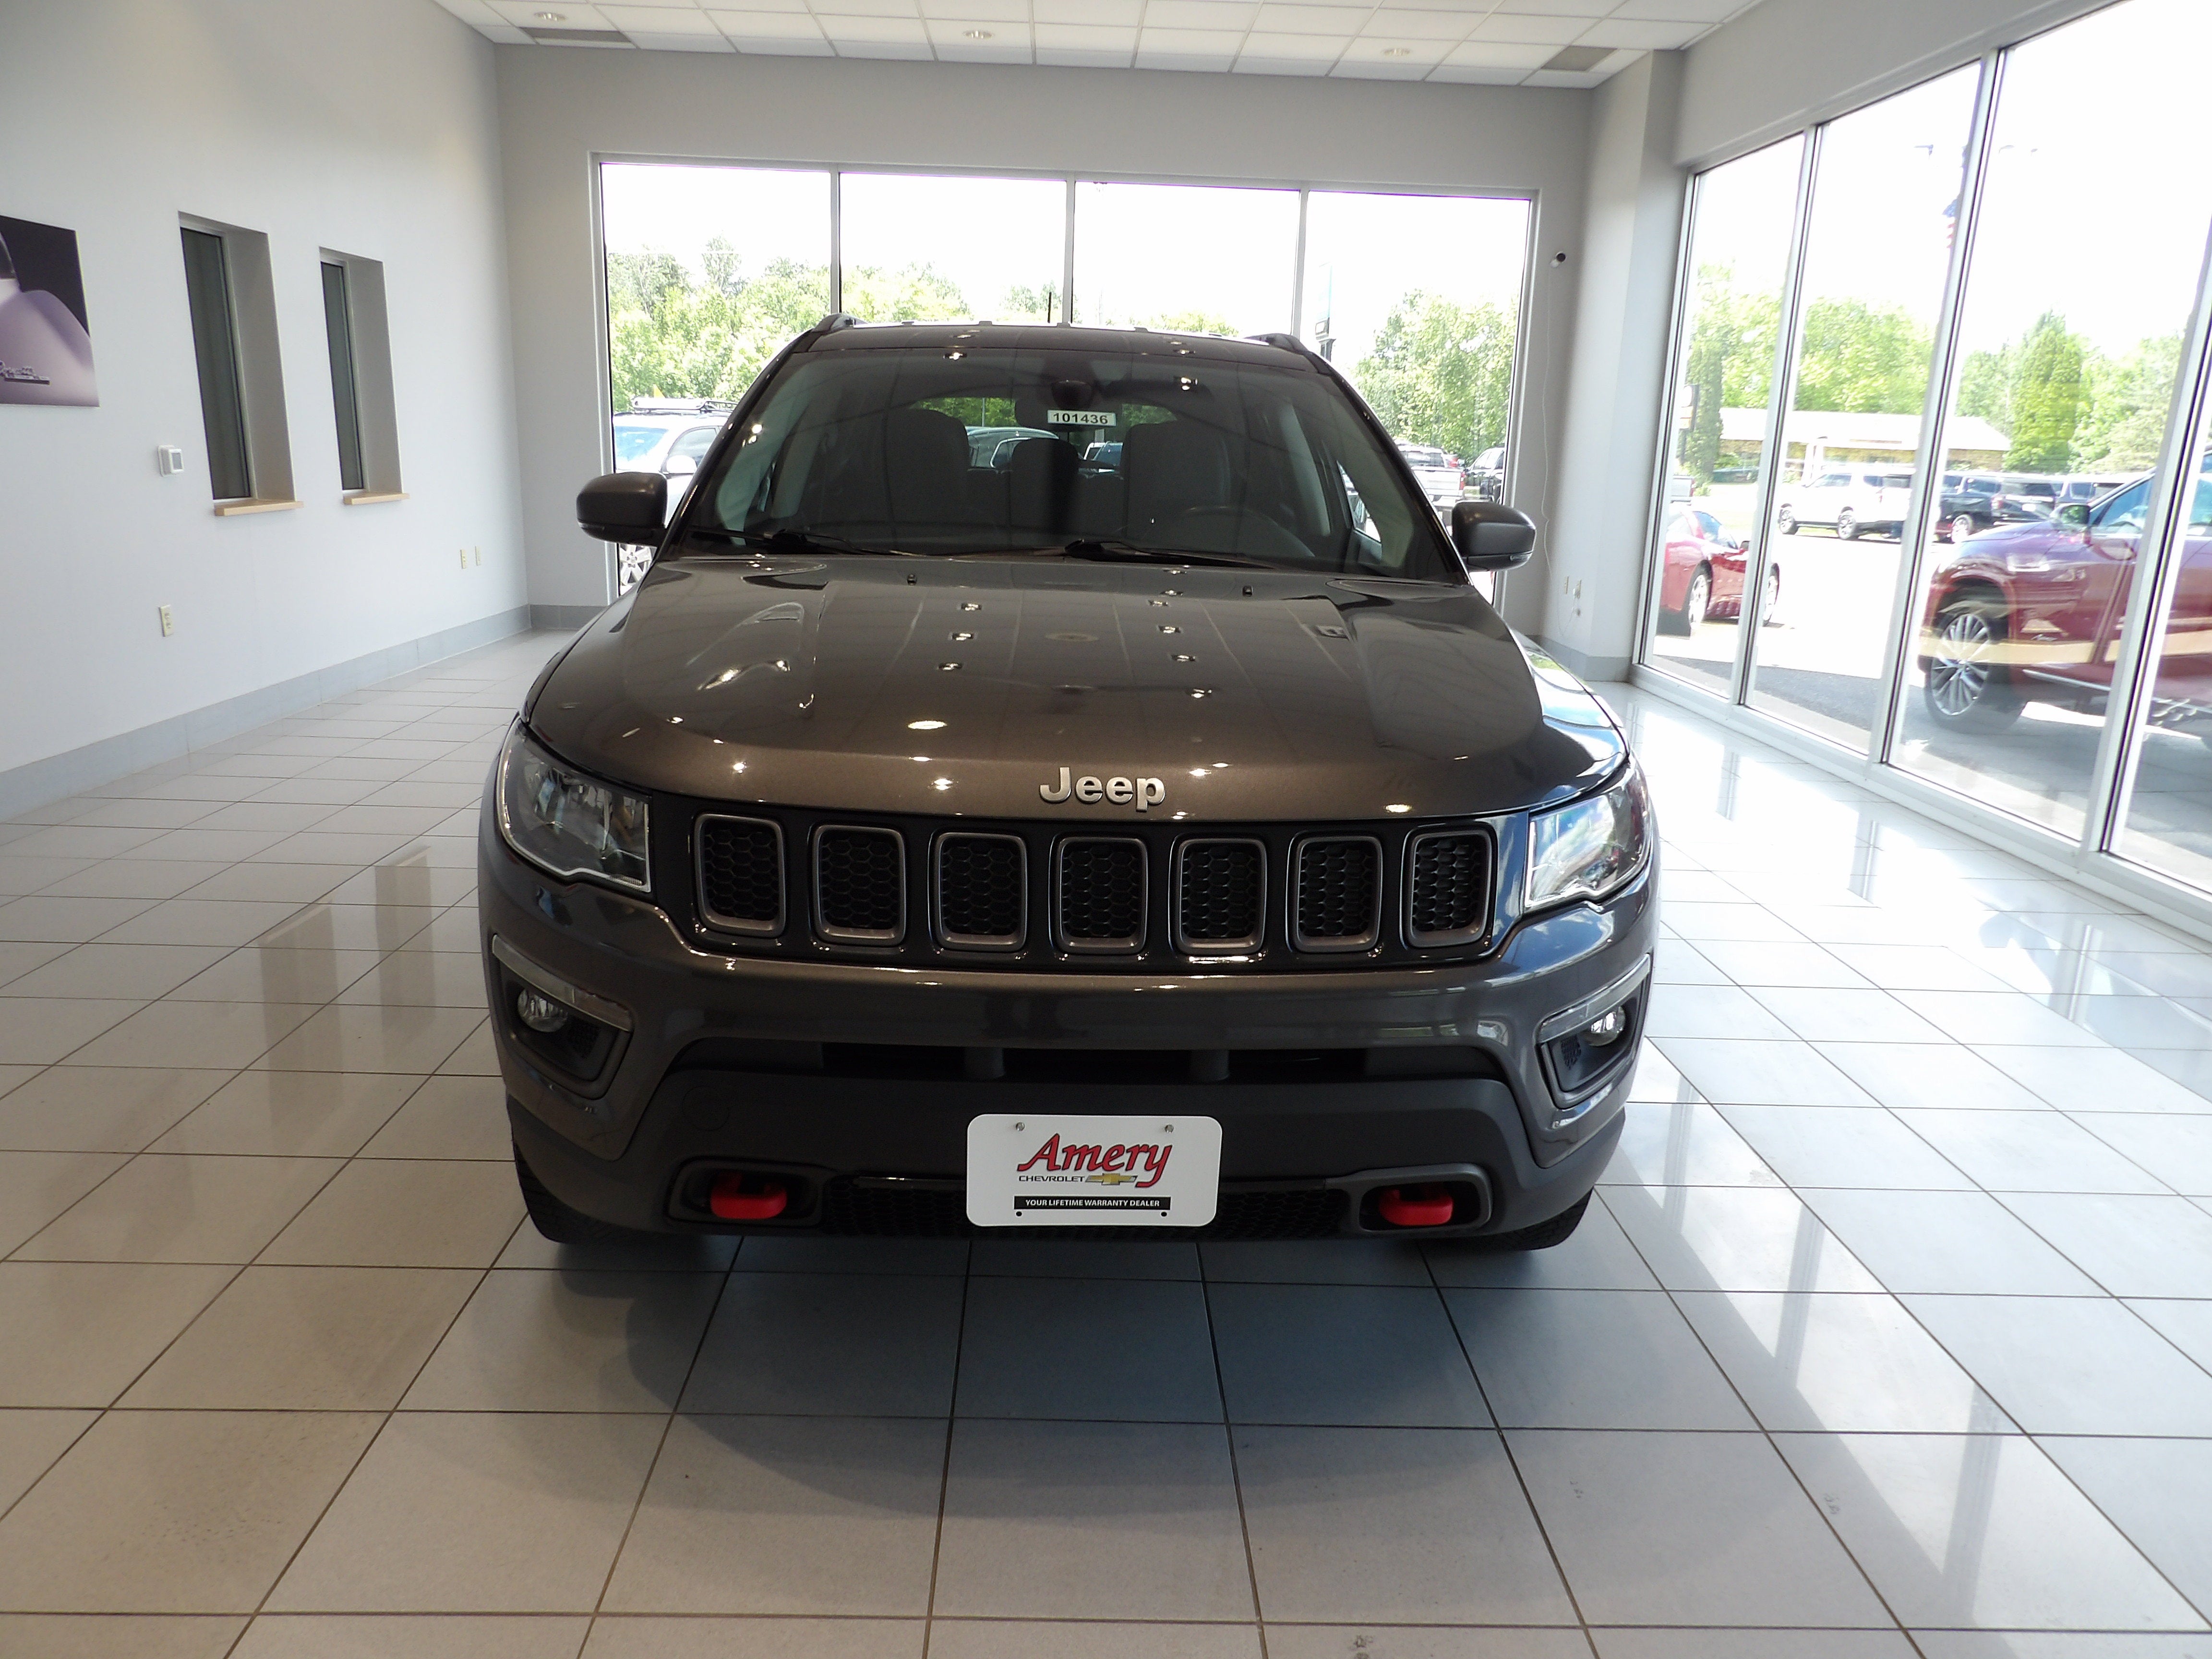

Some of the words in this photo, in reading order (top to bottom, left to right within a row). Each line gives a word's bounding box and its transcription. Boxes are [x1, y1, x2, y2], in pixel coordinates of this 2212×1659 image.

[1054, 413, 1108, 424] 101436
[1040, 767, 1166, 812] Jeep
[1017, 1133, 1173, 1188] Amery
